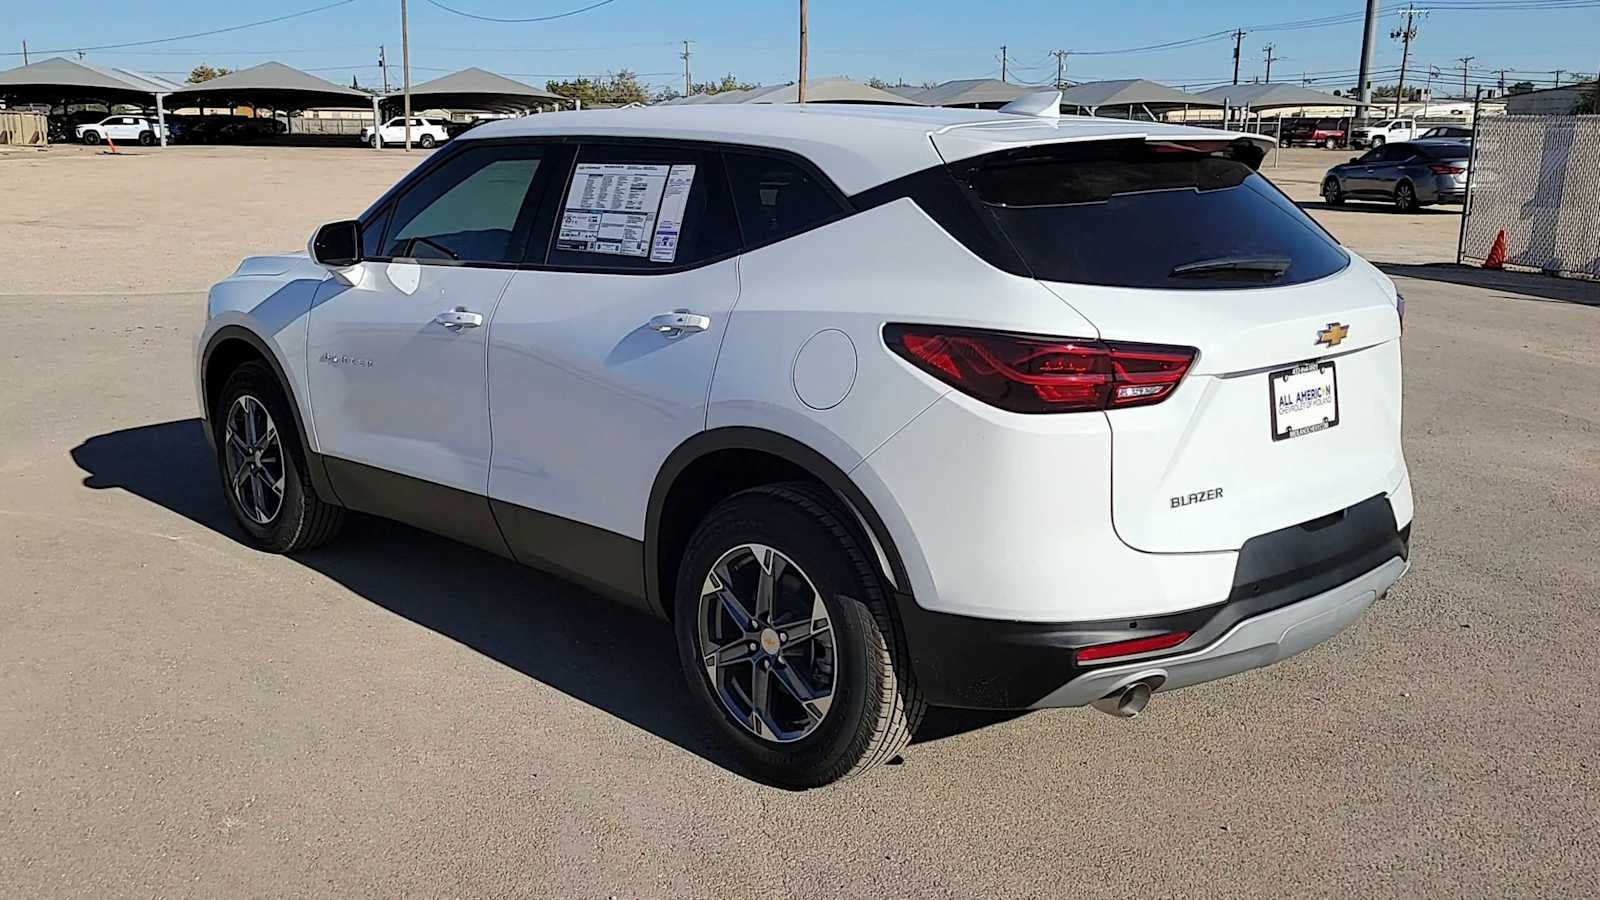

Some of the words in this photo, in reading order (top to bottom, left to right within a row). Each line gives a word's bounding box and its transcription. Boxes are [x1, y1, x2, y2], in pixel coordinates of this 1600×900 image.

[325, 352, 374, 369] BAER
[1279, 393, 1293, 407] ALL
[1170, 487, 1223, 509] BLAZER
